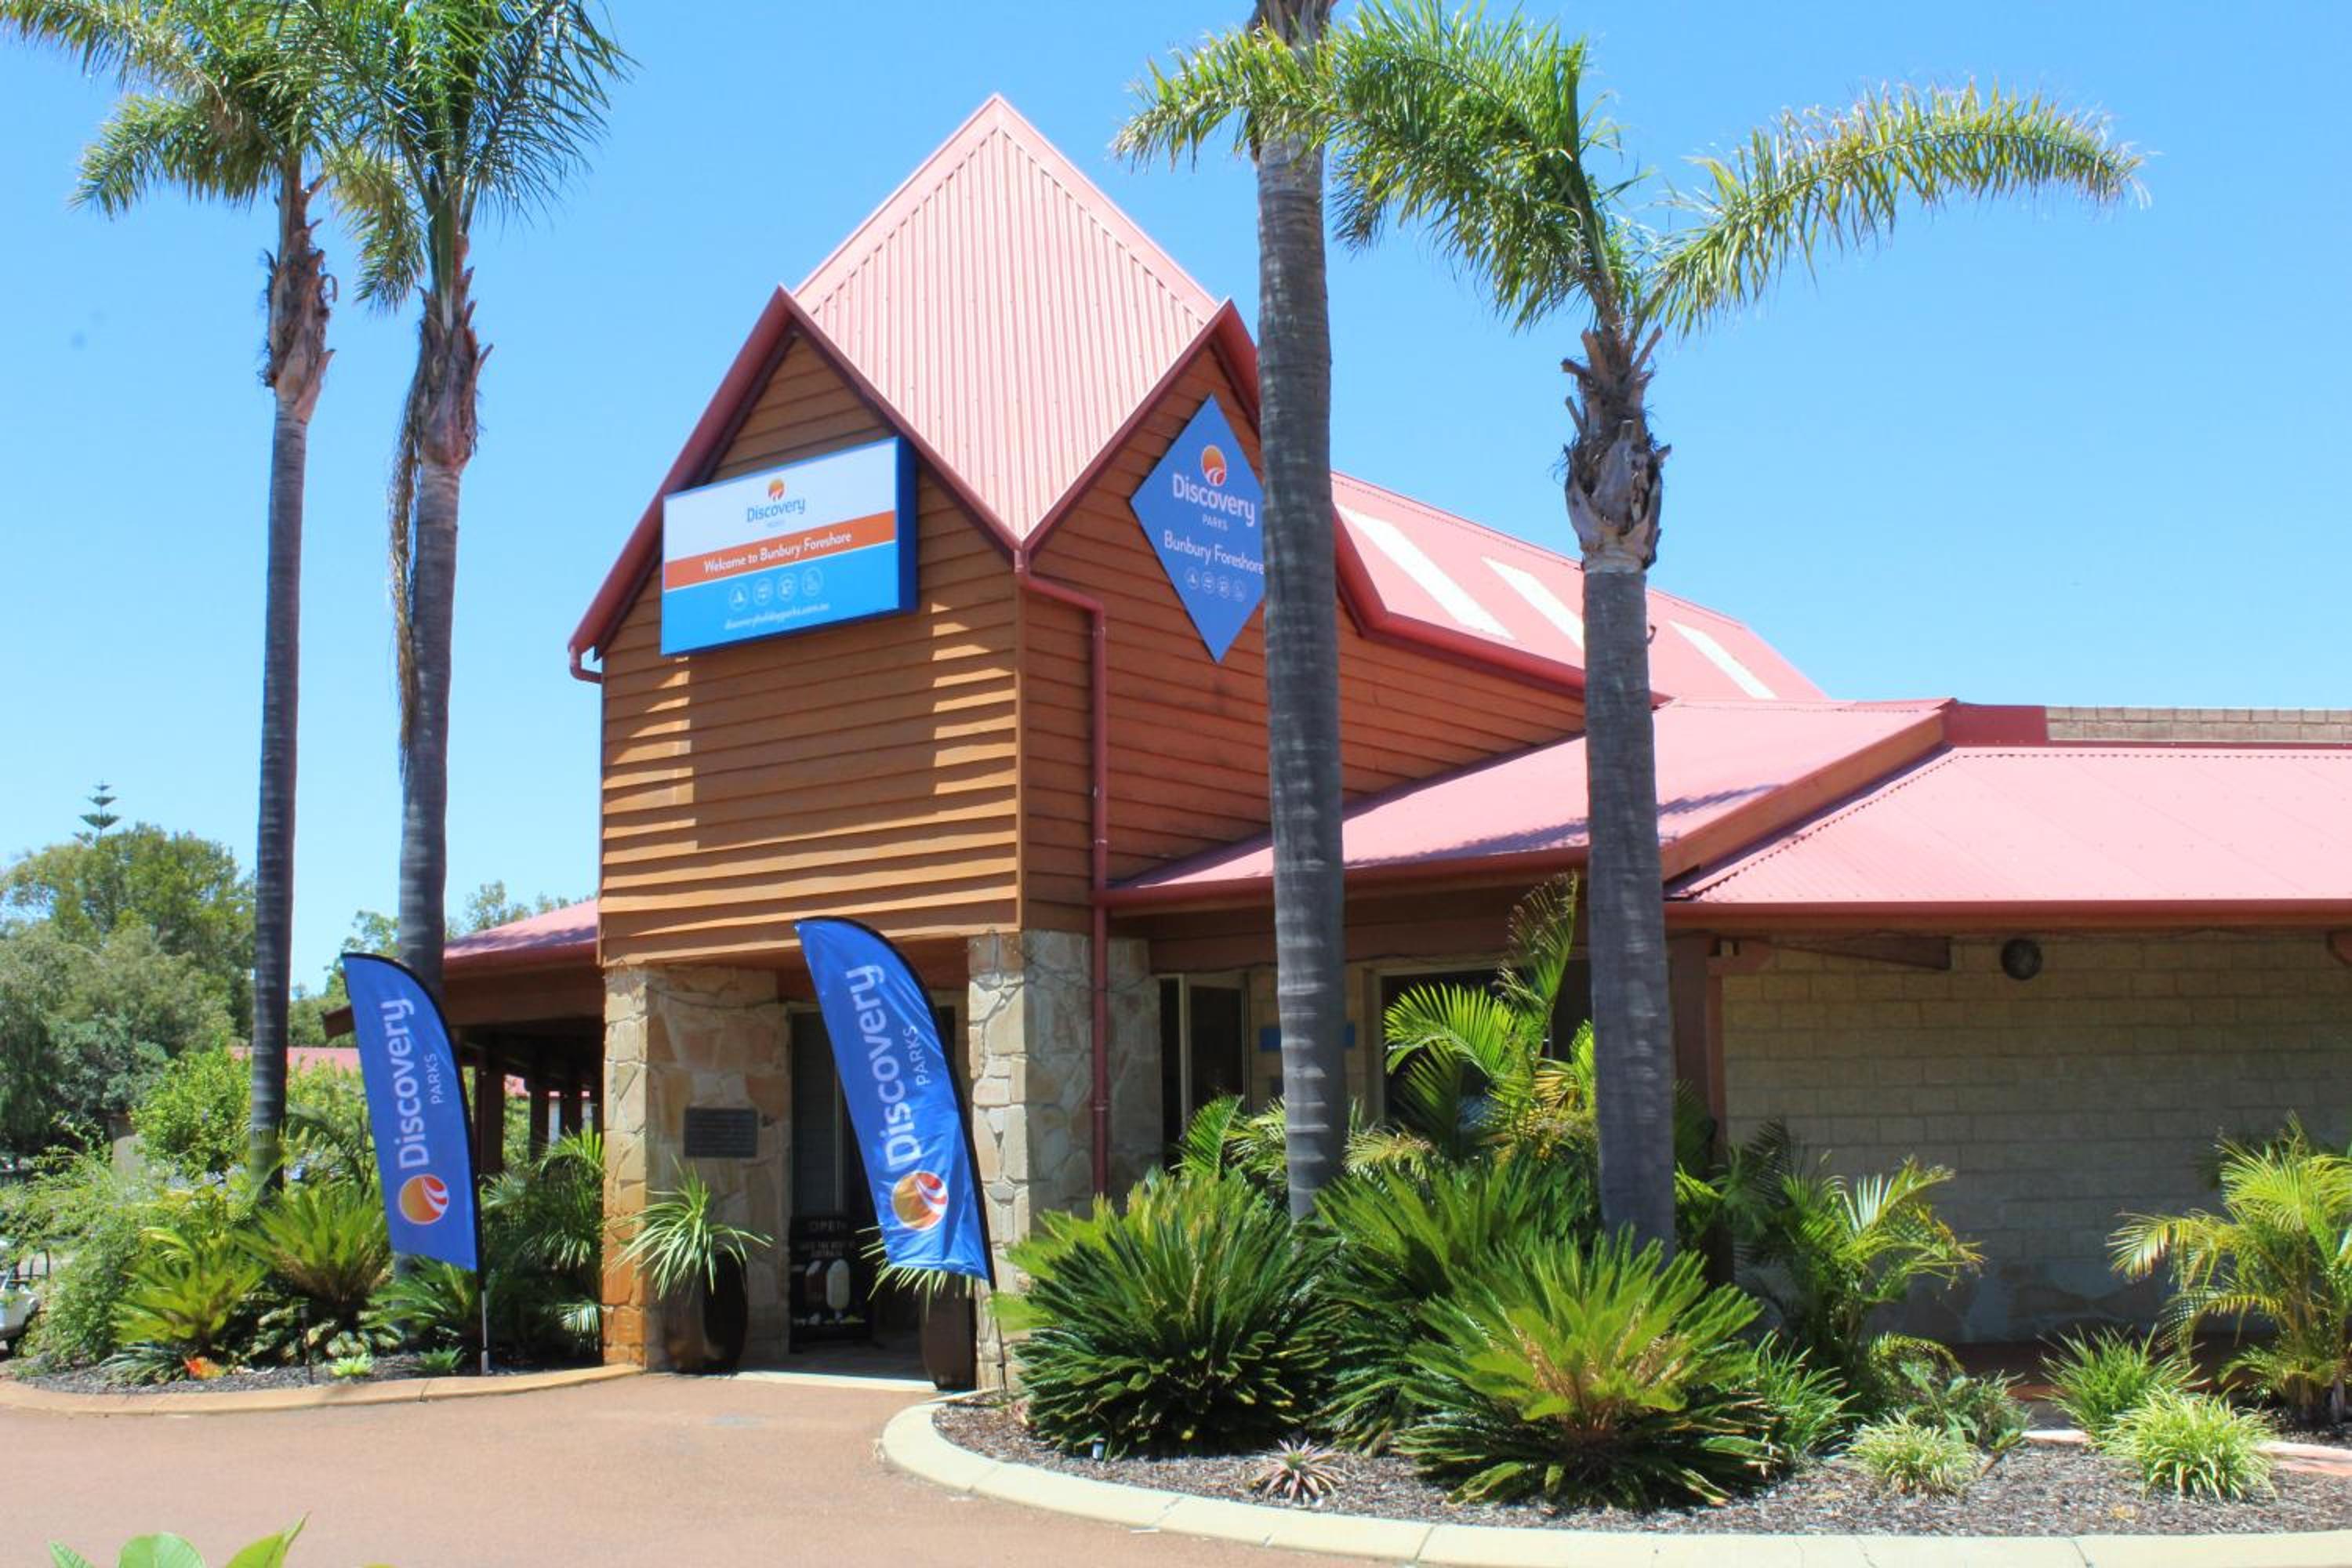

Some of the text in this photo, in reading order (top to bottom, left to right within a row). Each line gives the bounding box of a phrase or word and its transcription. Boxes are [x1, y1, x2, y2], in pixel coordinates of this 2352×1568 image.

[747, 499, 806, 522] Discovery
[1173, 473, 1255, 528] Discovery
[1203, 514, 1229, 532] PARKS
[704, 532, 852, 573] Welcome to Bunbury Foreshore
[1164, 529, 1264, 575] Bunbury Foreshore
[424, 1053, 442, 1104] PARKS
[846, 964, 922, 1167] Discovery
[903, 1025, 931, 1086] PARKS
[381, 997, 430, 1168] Discovery
